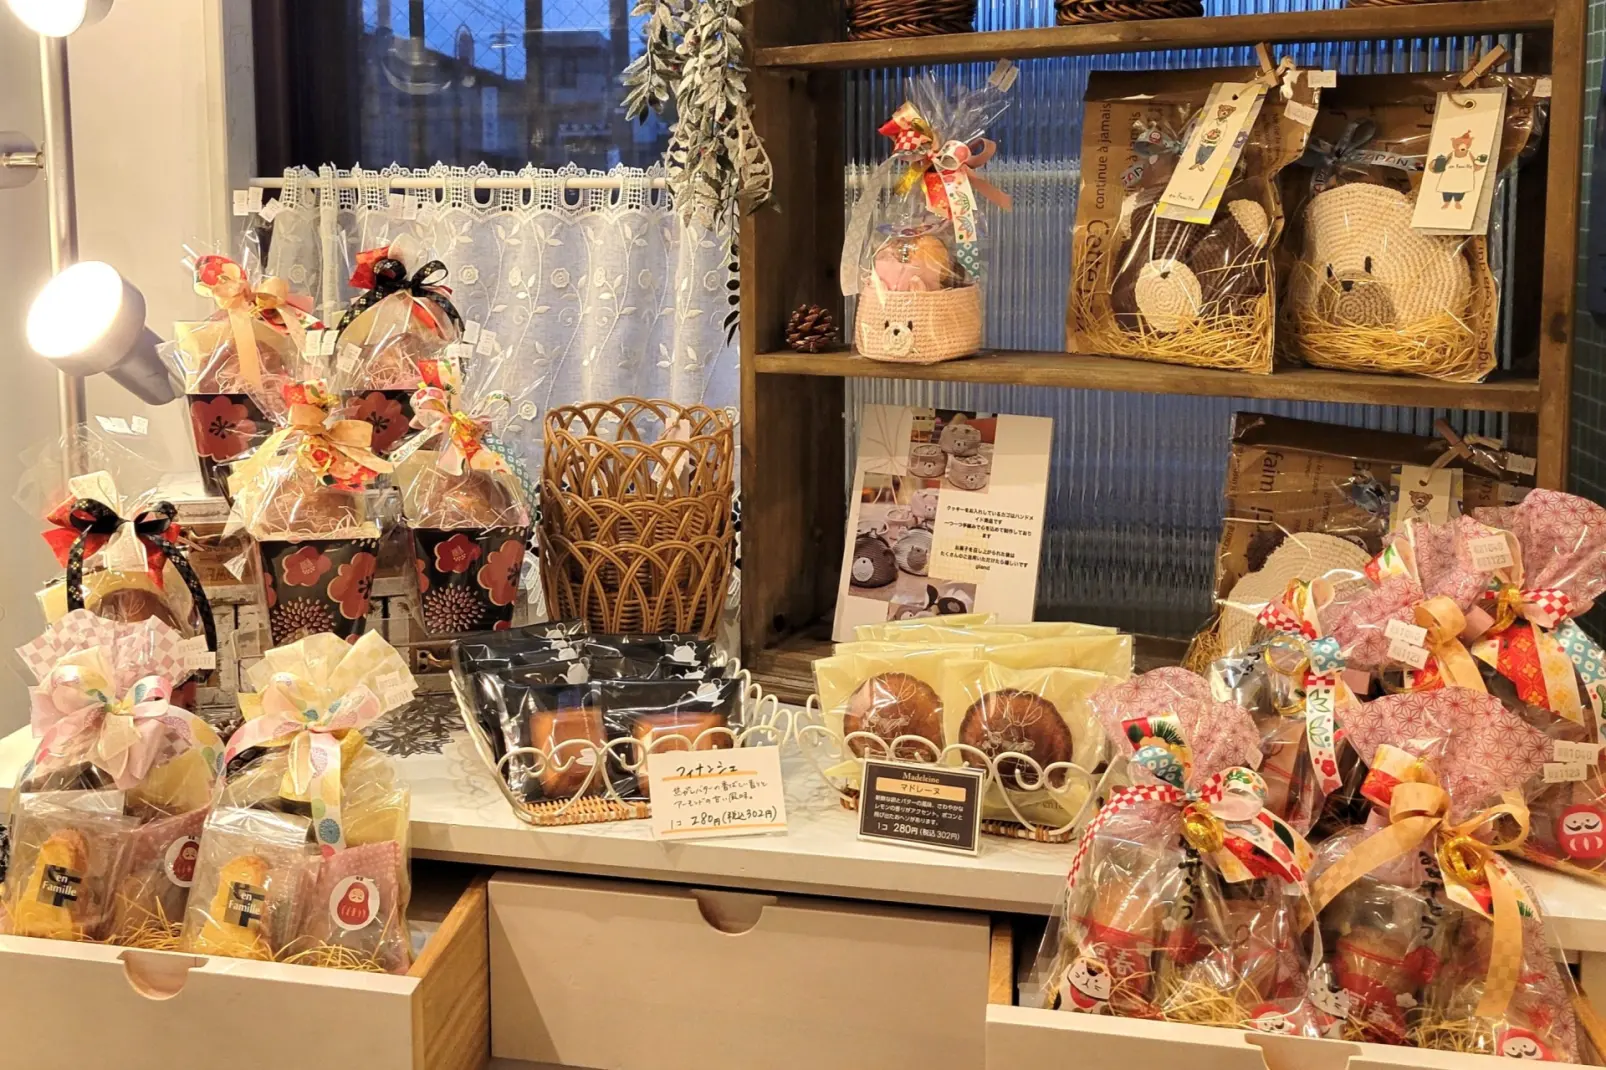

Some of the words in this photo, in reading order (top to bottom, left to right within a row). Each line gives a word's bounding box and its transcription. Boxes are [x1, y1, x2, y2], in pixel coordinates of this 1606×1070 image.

[676, 761, 737, 778] フィナンシェ
[902, 771, 940, 784] Madeleine
[900, 783, 941, 795] マドレーヌ
[56, 874, 69, 884] en
[42, 881, 77, 896] Famille
[241, 892, 253, 901] en
[228, 900, 260, 914] Famille
